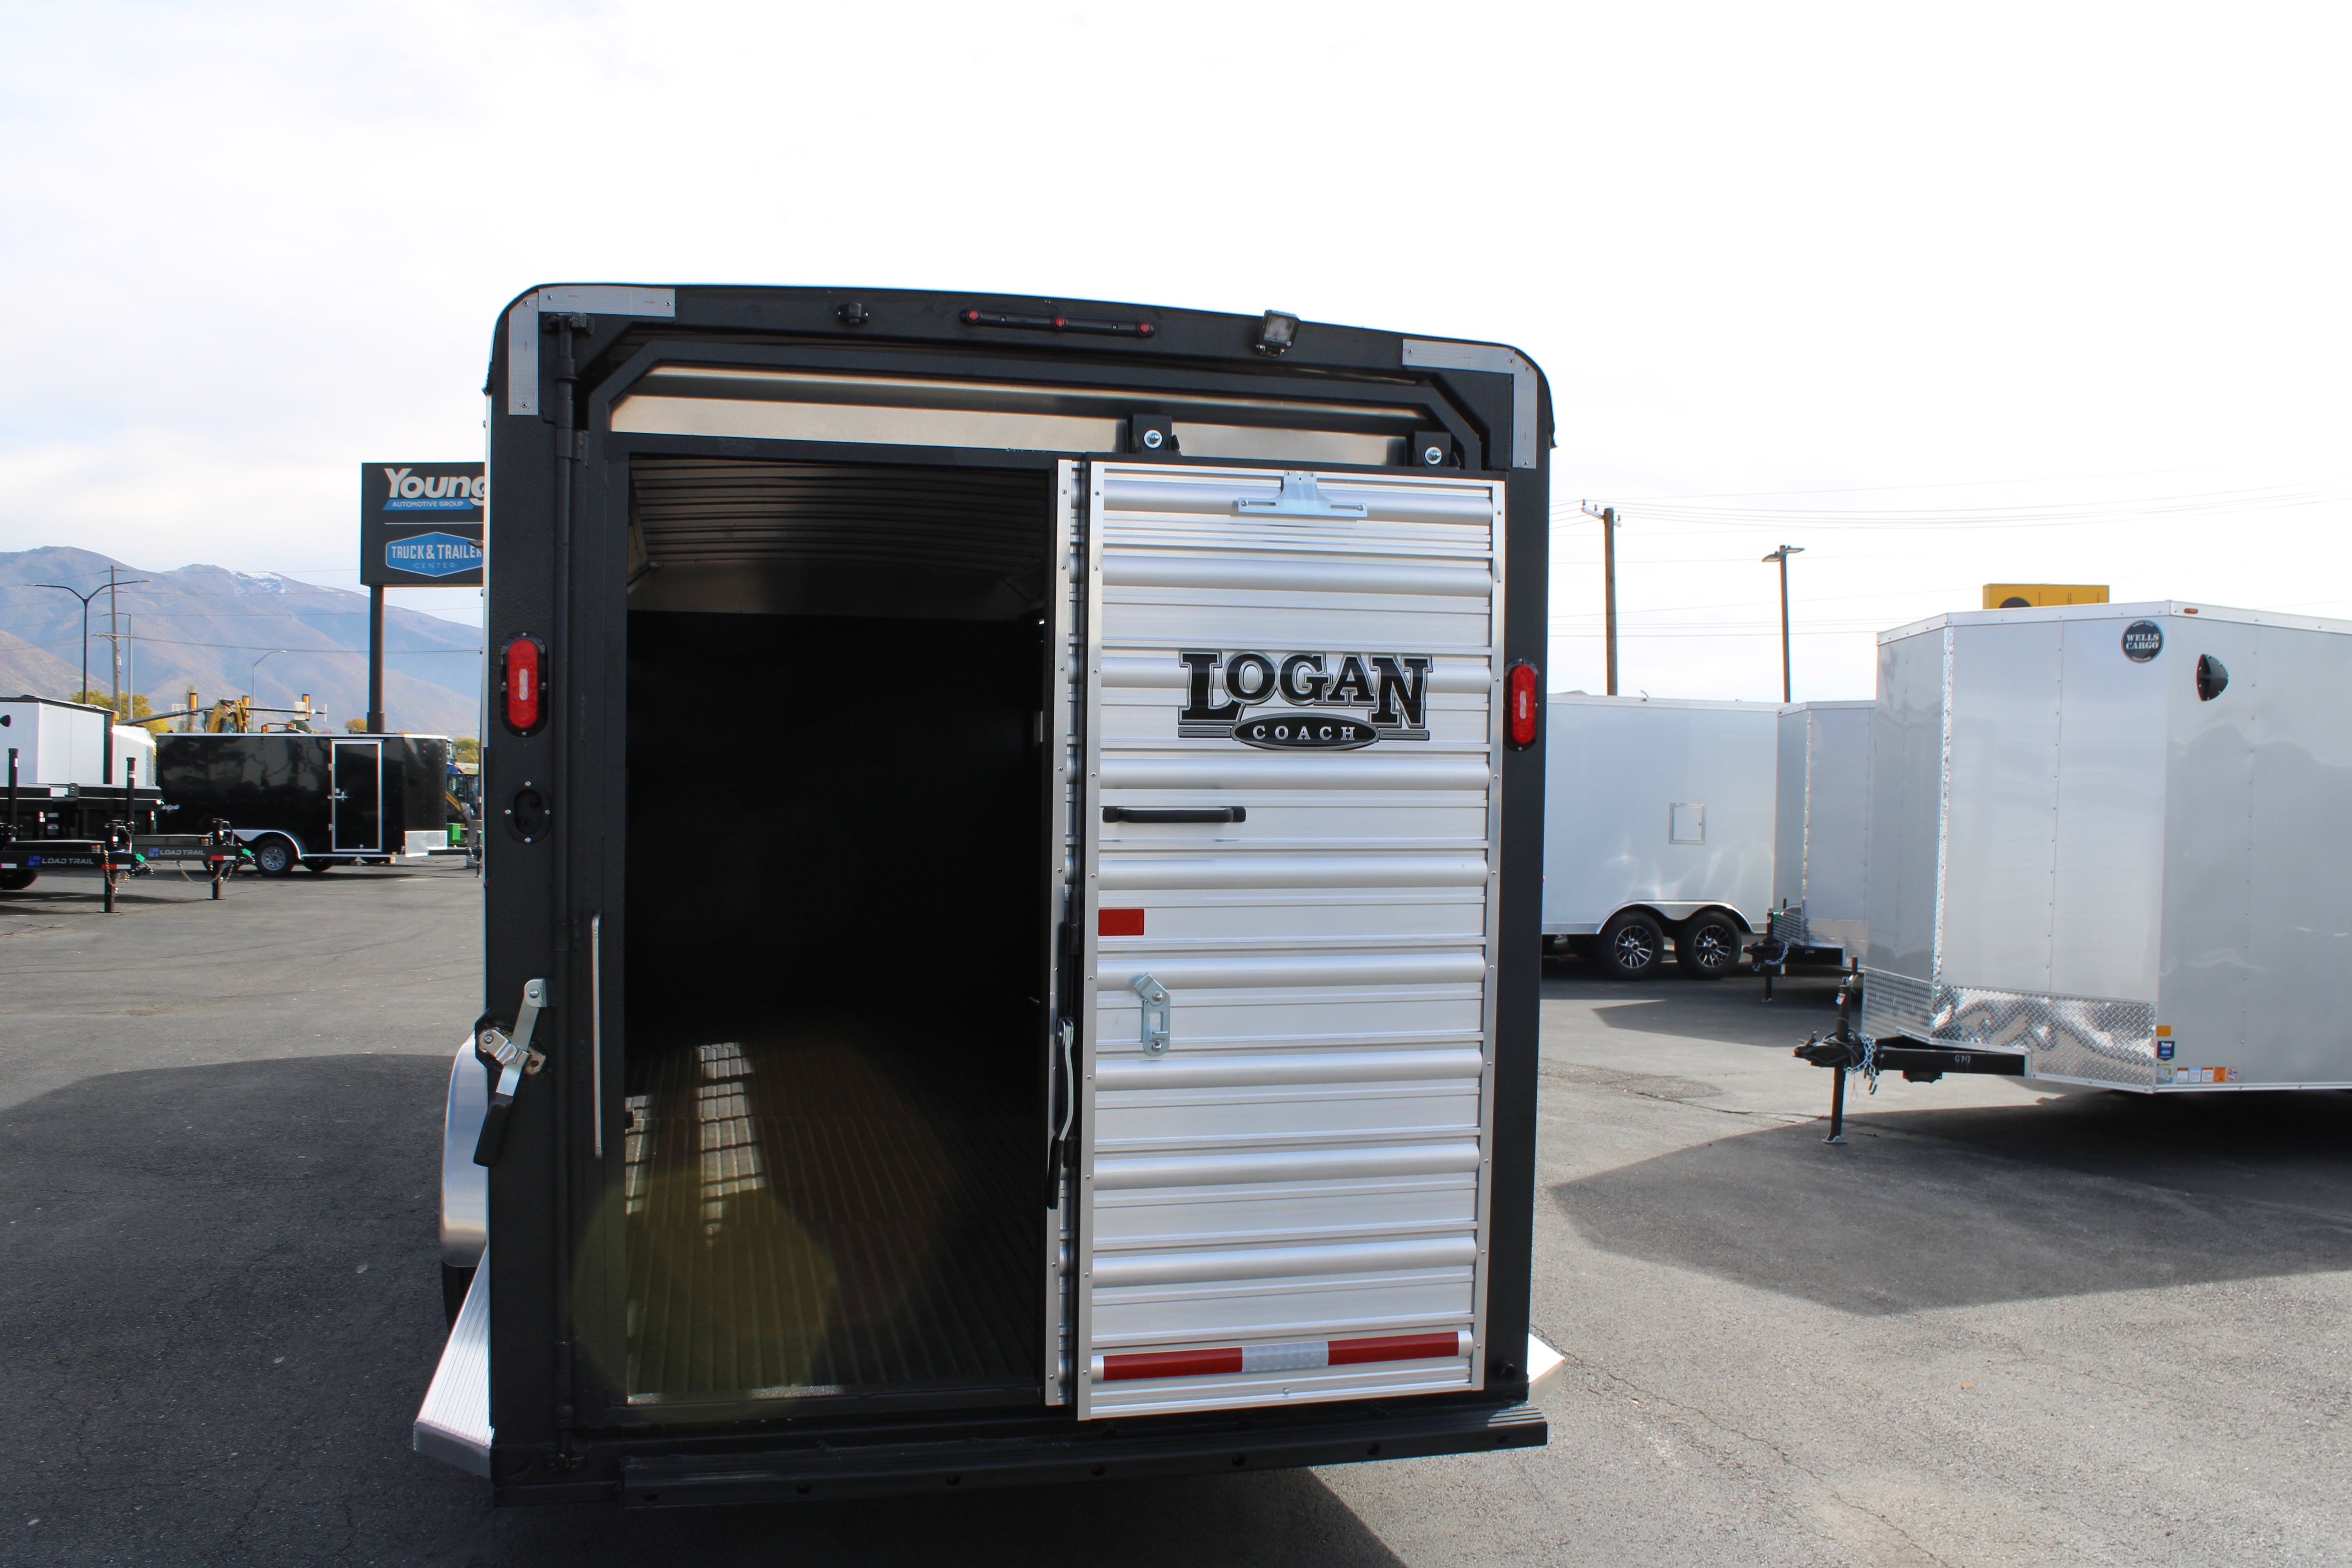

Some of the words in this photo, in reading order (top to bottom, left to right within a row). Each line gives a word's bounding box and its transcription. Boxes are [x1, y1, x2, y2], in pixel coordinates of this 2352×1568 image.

[384, 468, 484, 506] Young
[391, 545, 425, 559] TRUCK
[426, 545, 435, 559] &
[2126, 633, 2160, 641] WELLS
[2125, 641, 2160, 650] CARGO
[1178, 648, 1432, 728] LOGAN
[1253, 725, 1355, 740] COACH
